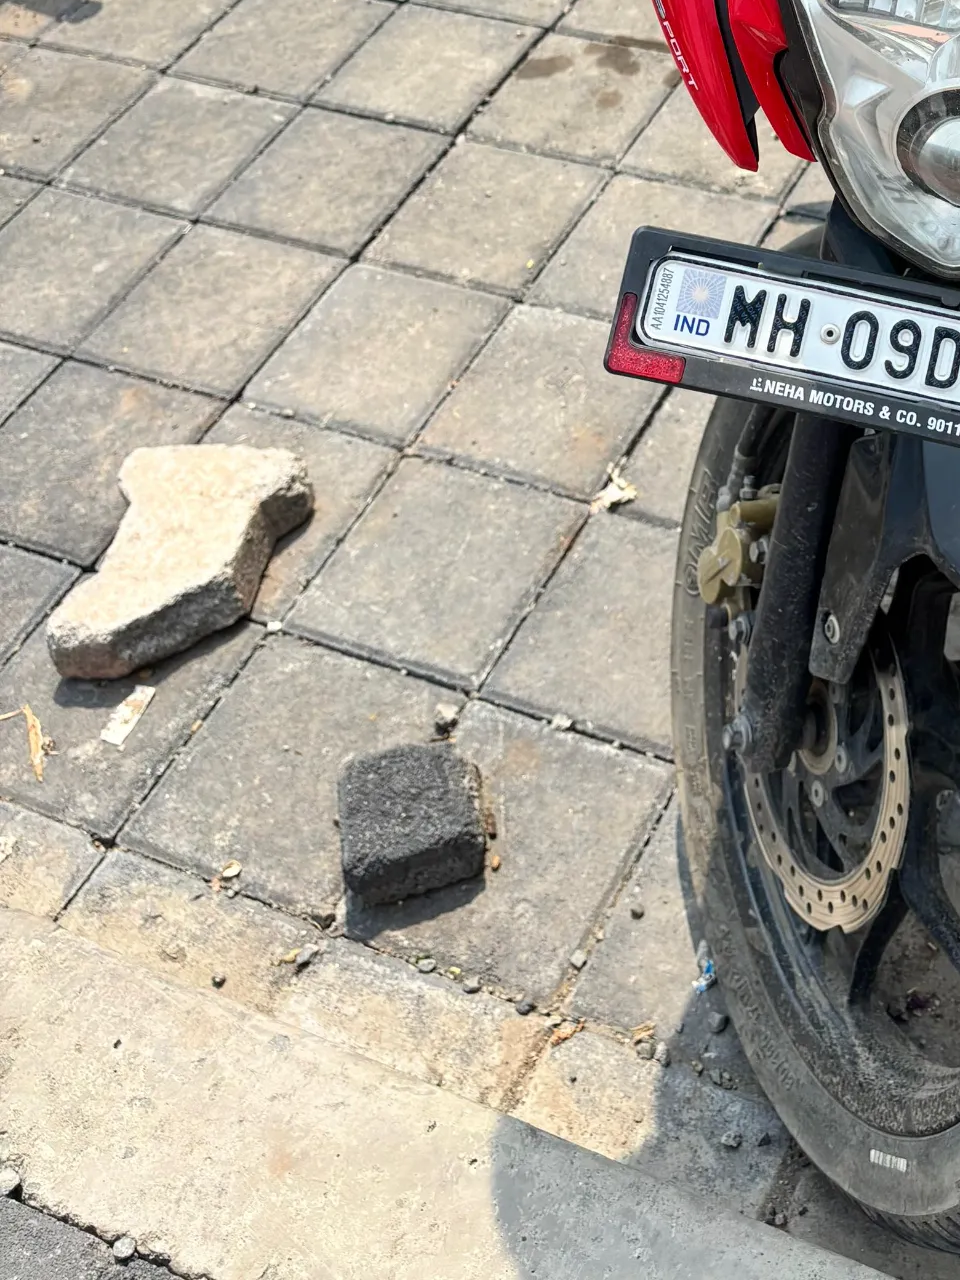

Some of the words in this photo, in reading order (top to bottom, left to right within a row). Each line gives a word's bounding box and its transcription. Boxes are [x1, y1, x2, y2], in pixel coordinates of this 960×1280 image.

[673, 314, 711, 336] IND
[724, 285, 811, 357] MH
[763, 379, 805, 401] NEHA
[808, 389, 875, 416] MOTORS
[878, 405, 891, 421] &
[895, 409, 921, 427] CO.
